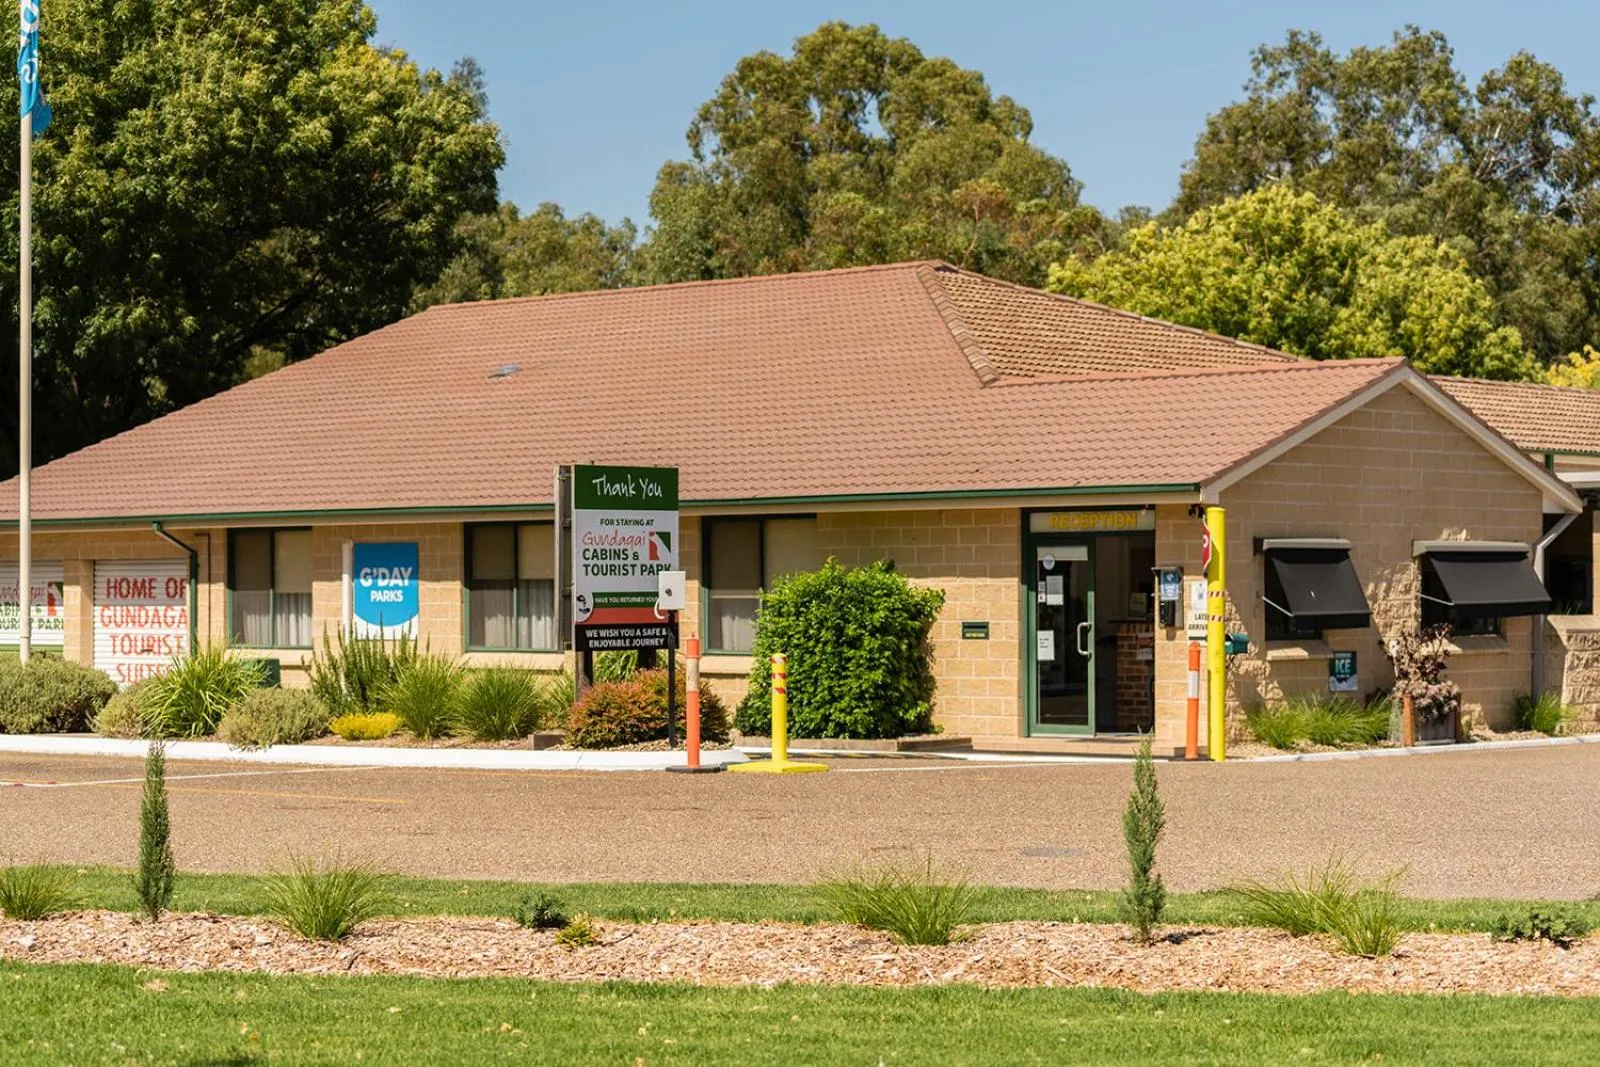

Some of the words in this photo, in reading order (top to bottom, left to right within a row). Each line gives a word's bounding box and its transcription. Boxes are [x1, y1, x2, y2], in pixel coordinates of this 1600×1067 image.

[592, 474, 637, 497] Thank
[639, 478, 663, 500] You
[600, 518, 615, 527] FOR
[616, 518, 645, 527] STAYING
[645, 518, 654, 527] AT
[1048, 511, 1138, 529] RECEPTION
[582, 529, 646, 550] Gundagai
[582, 548, 629, 561] CABINS
[632, 551, 640, 561] &
[583, 564, 637, 577] TOURIST
[106, 576, 157, 600] HOME
[165, 576, 188, 600] OF
[370, 589, 404, 603] PARKS
[100, 604, 189, 629] GUNDAGA
[585, 629, 598, 638] WE
[599, 628, 619, 638] WISH
[620, 628, 635, 637] YOU
[635, 628, 641, 636] A
[642, 628, 660, 637] SAFE
[661, 627, 667, 636] &
[110, 633, 183, 656] TOURIST
[588, 638, 631, 648] ENJOYABLE
[631, 637, 665, 647] JOURNEY
[1335, 659, 1352, 674] ICE
